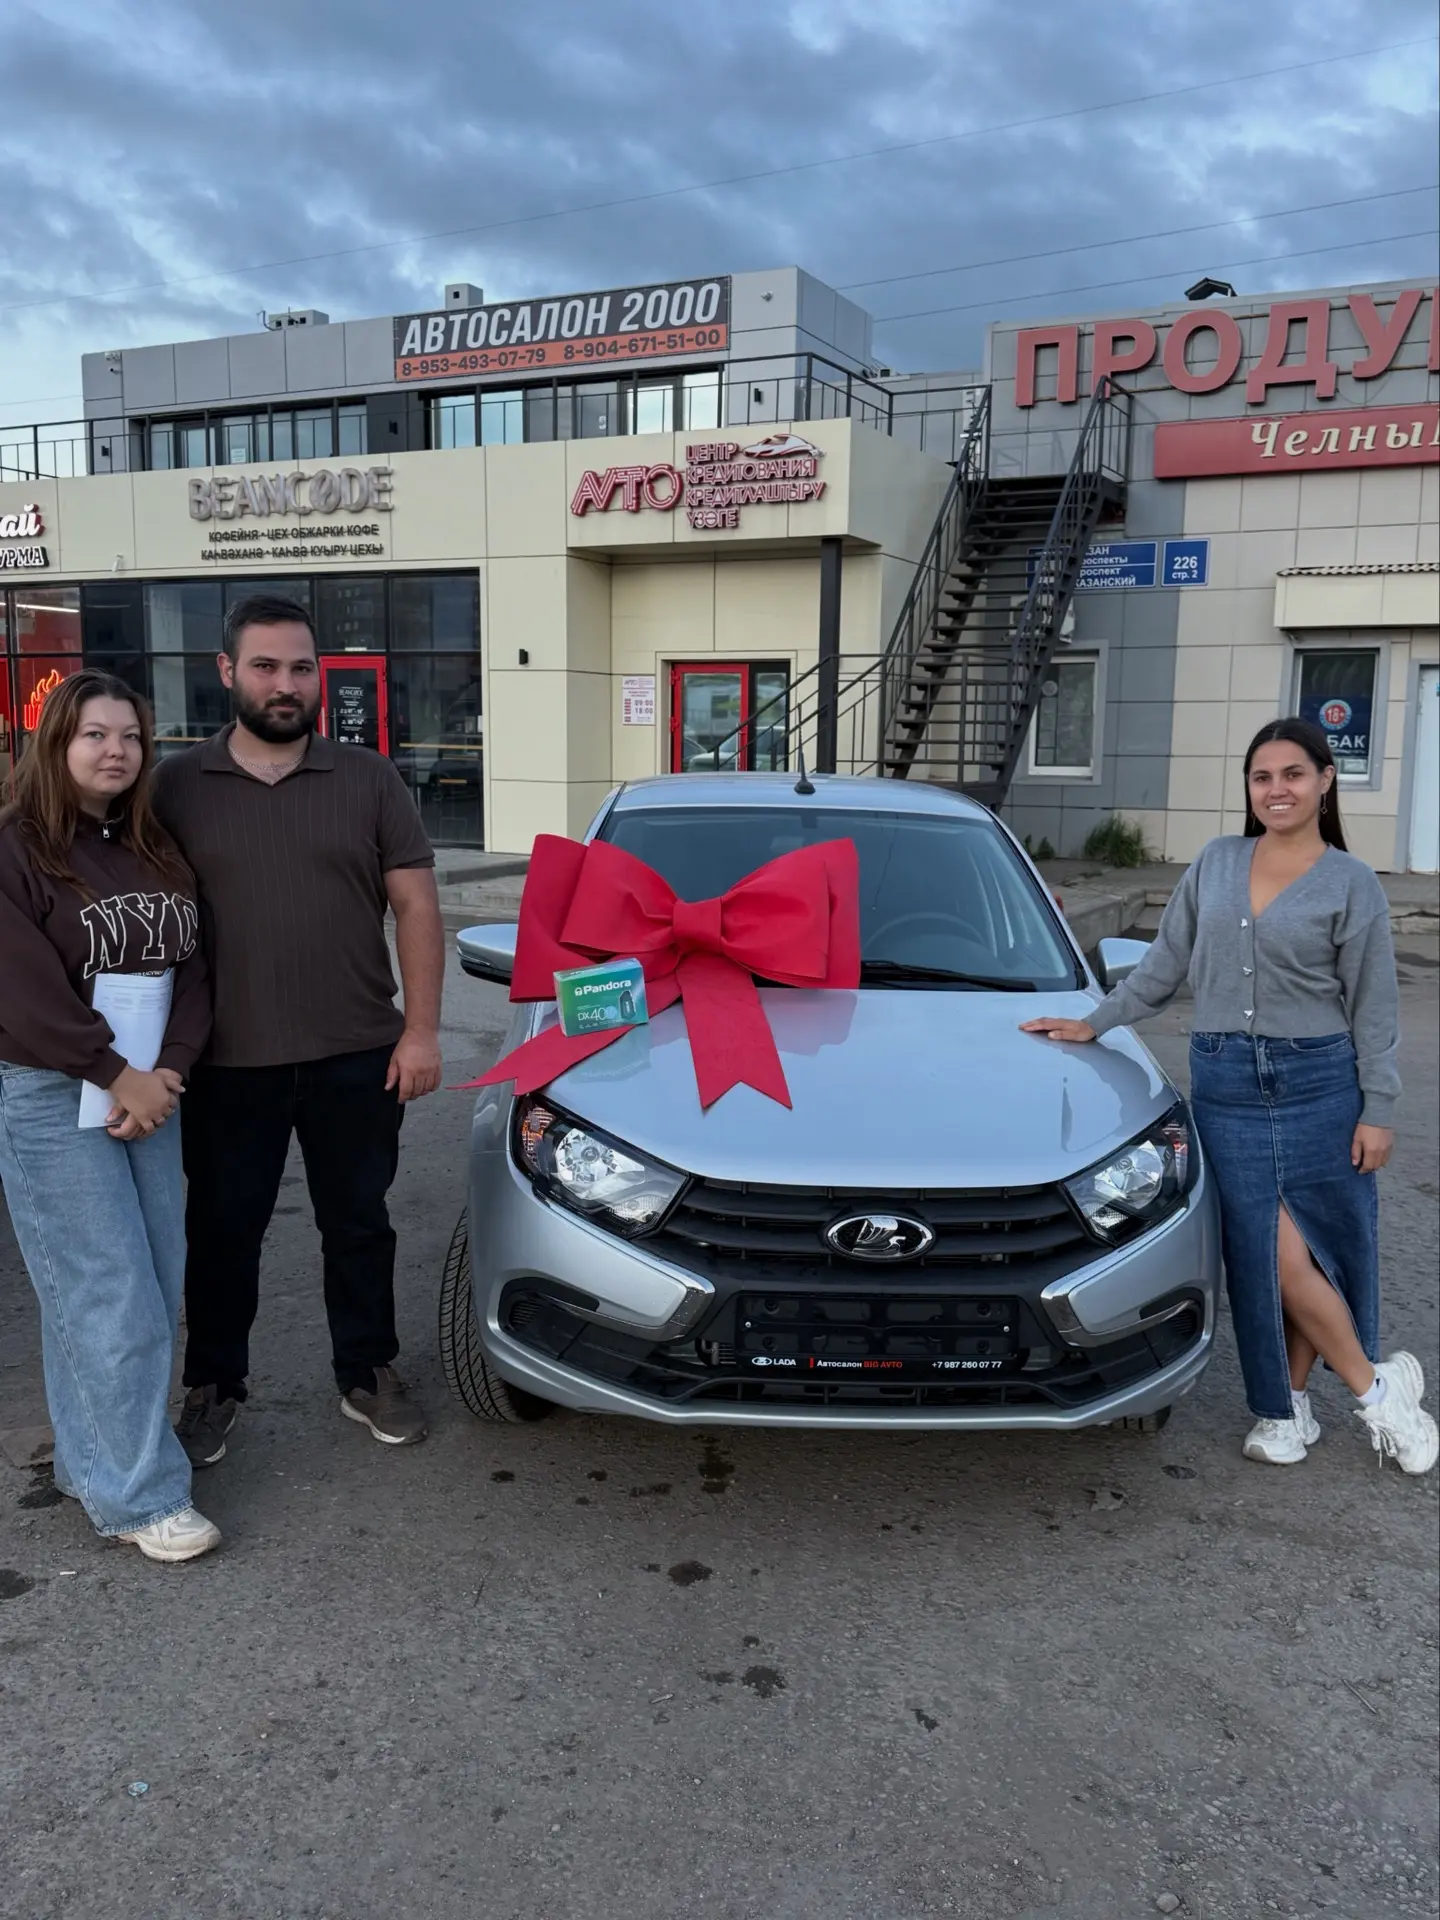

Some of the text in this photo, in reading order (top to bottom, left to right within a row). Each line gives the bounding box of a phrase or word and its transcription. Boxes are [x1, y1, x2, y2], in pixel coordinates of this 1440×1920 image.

[401, 282, 722, 356] АВТОСАЛОН 2000
[402, 329, 721, 377] 8-953-493-07-79 8-904-671-51-00
[1015, 289, 1440, 407] ПРОДУ
[1251, 416, 1440, 458] Челны
[685, 442, 738, 464] ЦЕНТР
[685, 458, 817, 484] КРЕДИТОВАНИЯ
[684, 481, 825, 507] КРЕДИТЛАШТЫРУ
[0, 503, 42, 537] ай
[209, 524, 380, 542] КОФЕЙНЯ ЦЕХ ОБЖАРКИ КОФЕ
[1086, 546, 1110, 556] ЗАН
[1082, 556, 1128, 565] оспекты
[1173, 556, 1198, 570] 226
[1080, 567, 1121, 577] роспект
[1171, 570, 1198, 580] стр. 2
[1327, 734, 1366, 748] БАК
[584, 980, 632, 995] Pandora
[773, 1358, 796, 1366] LADA
[817, 1360, 862, 1368] Автосалон
